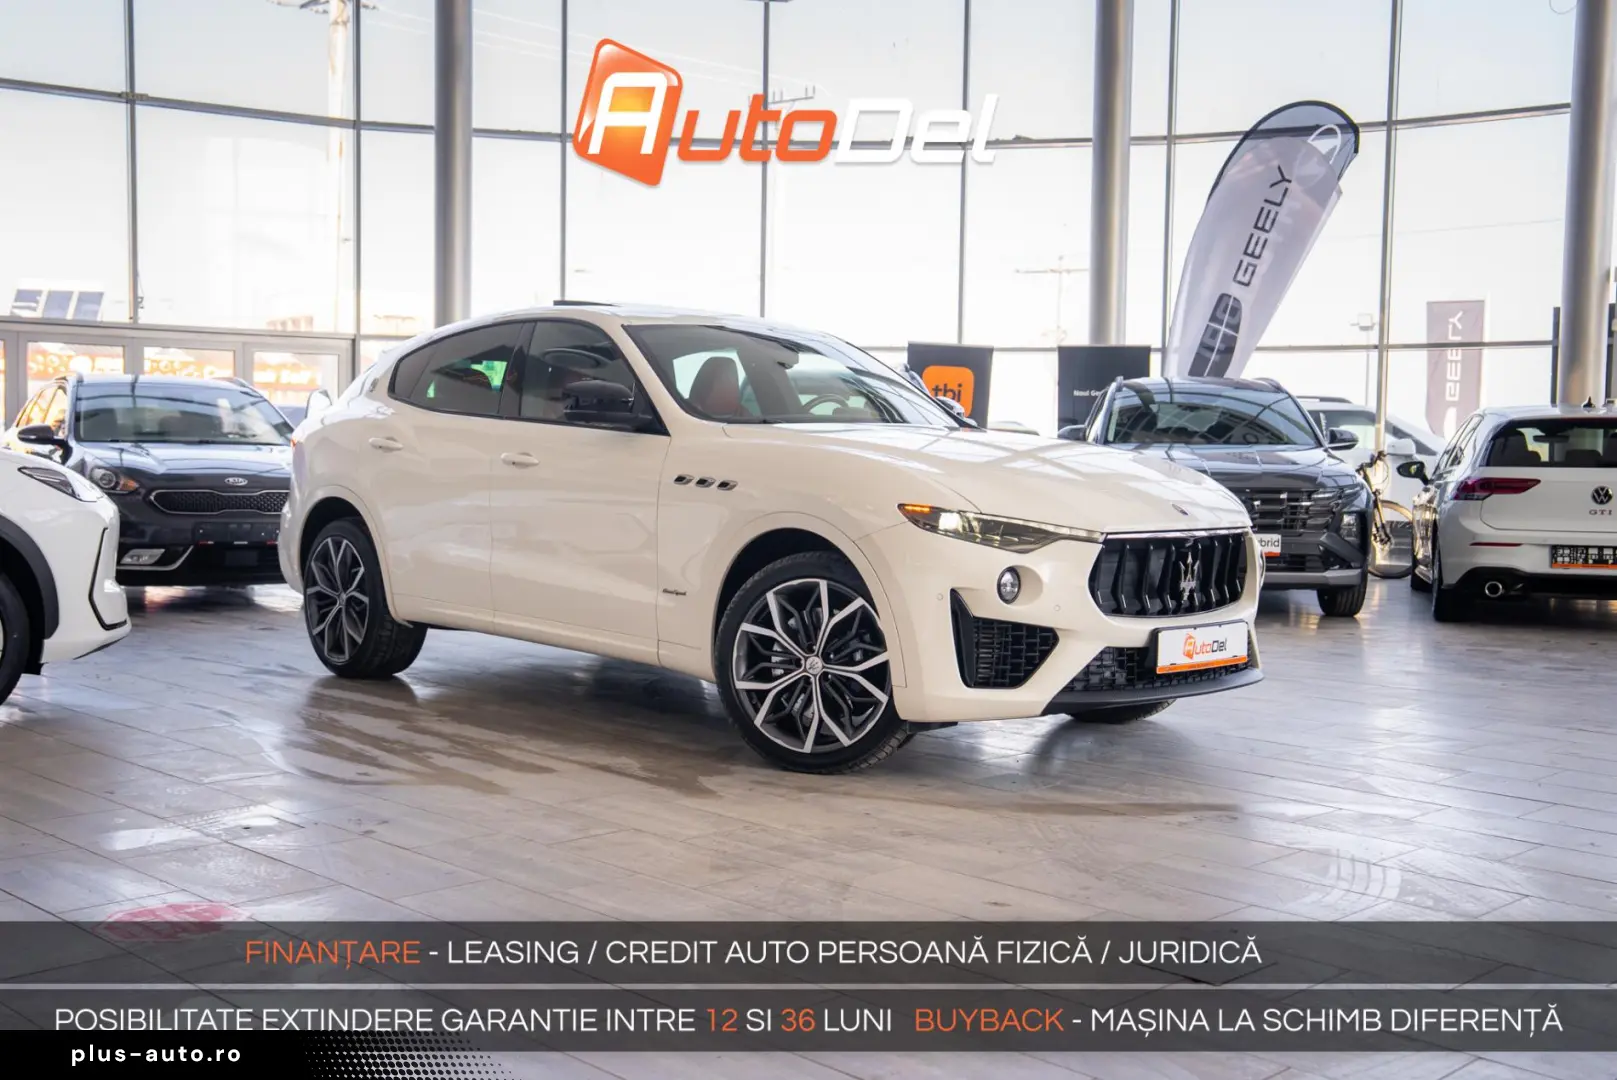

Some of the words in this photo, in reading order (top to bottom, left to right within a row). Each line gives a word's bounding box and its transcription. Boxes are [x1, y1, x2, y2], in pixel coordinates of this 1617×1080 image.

[1232, 164, 1292, 287] GEELY
[1588, 508, 1613, 516] GTI
[1183, 636, 1228, 658] AutoDel
